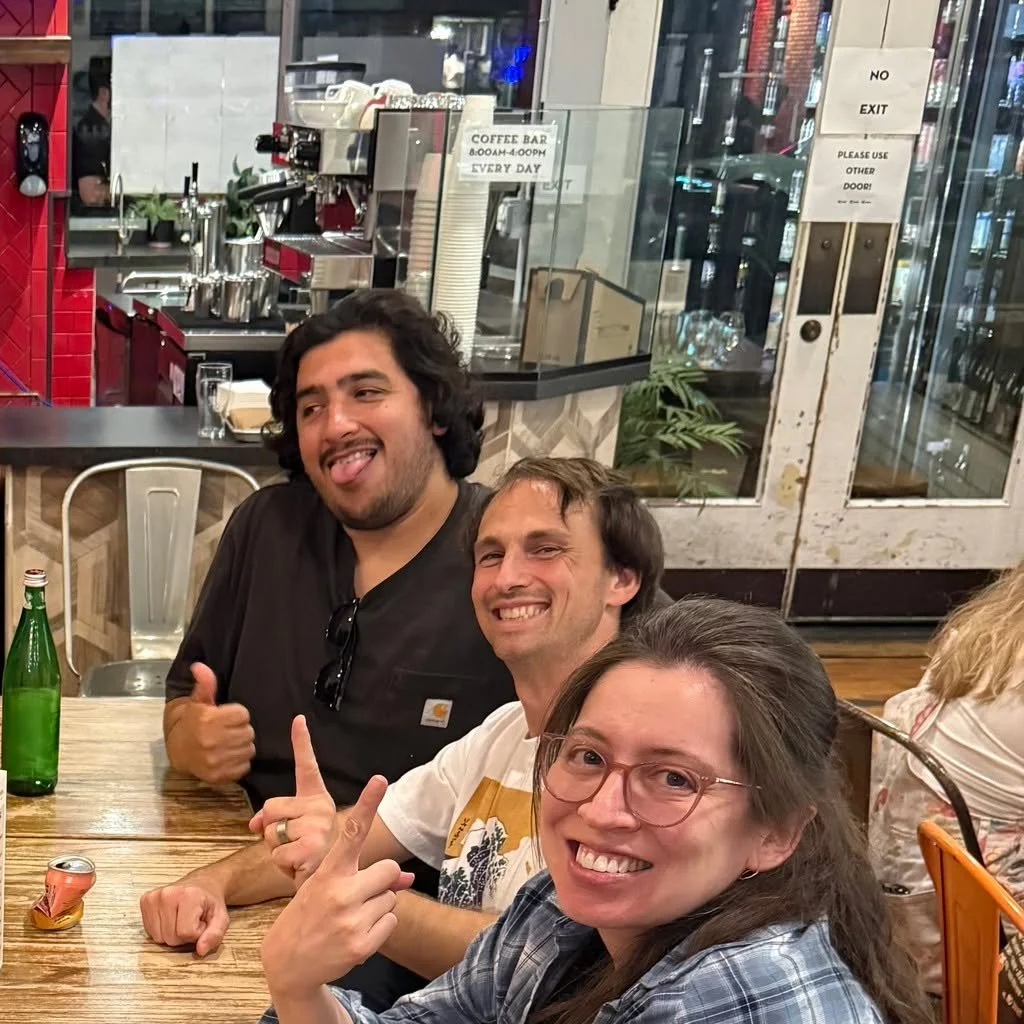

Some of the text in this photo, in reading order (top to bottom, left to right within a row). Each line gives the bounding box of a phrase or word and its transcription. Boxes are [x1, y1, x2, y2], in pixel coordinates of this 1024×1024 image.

[870, 70, 889, 81] NO
[859, 104, 888, 115] EXIT
[471, 134, 548, 145] COFFEE BAR
[469, 148, 546, 157] 8:00AM-4:00PM
[837, 151, 888, 160] PLEASE USE
[471, 163, 542, 173] EVERY DAY
[846, 167, 875, 175] OTHER
[542, 179, 573, 191] EXT
[843, 182, 872, 191] DOOR!
